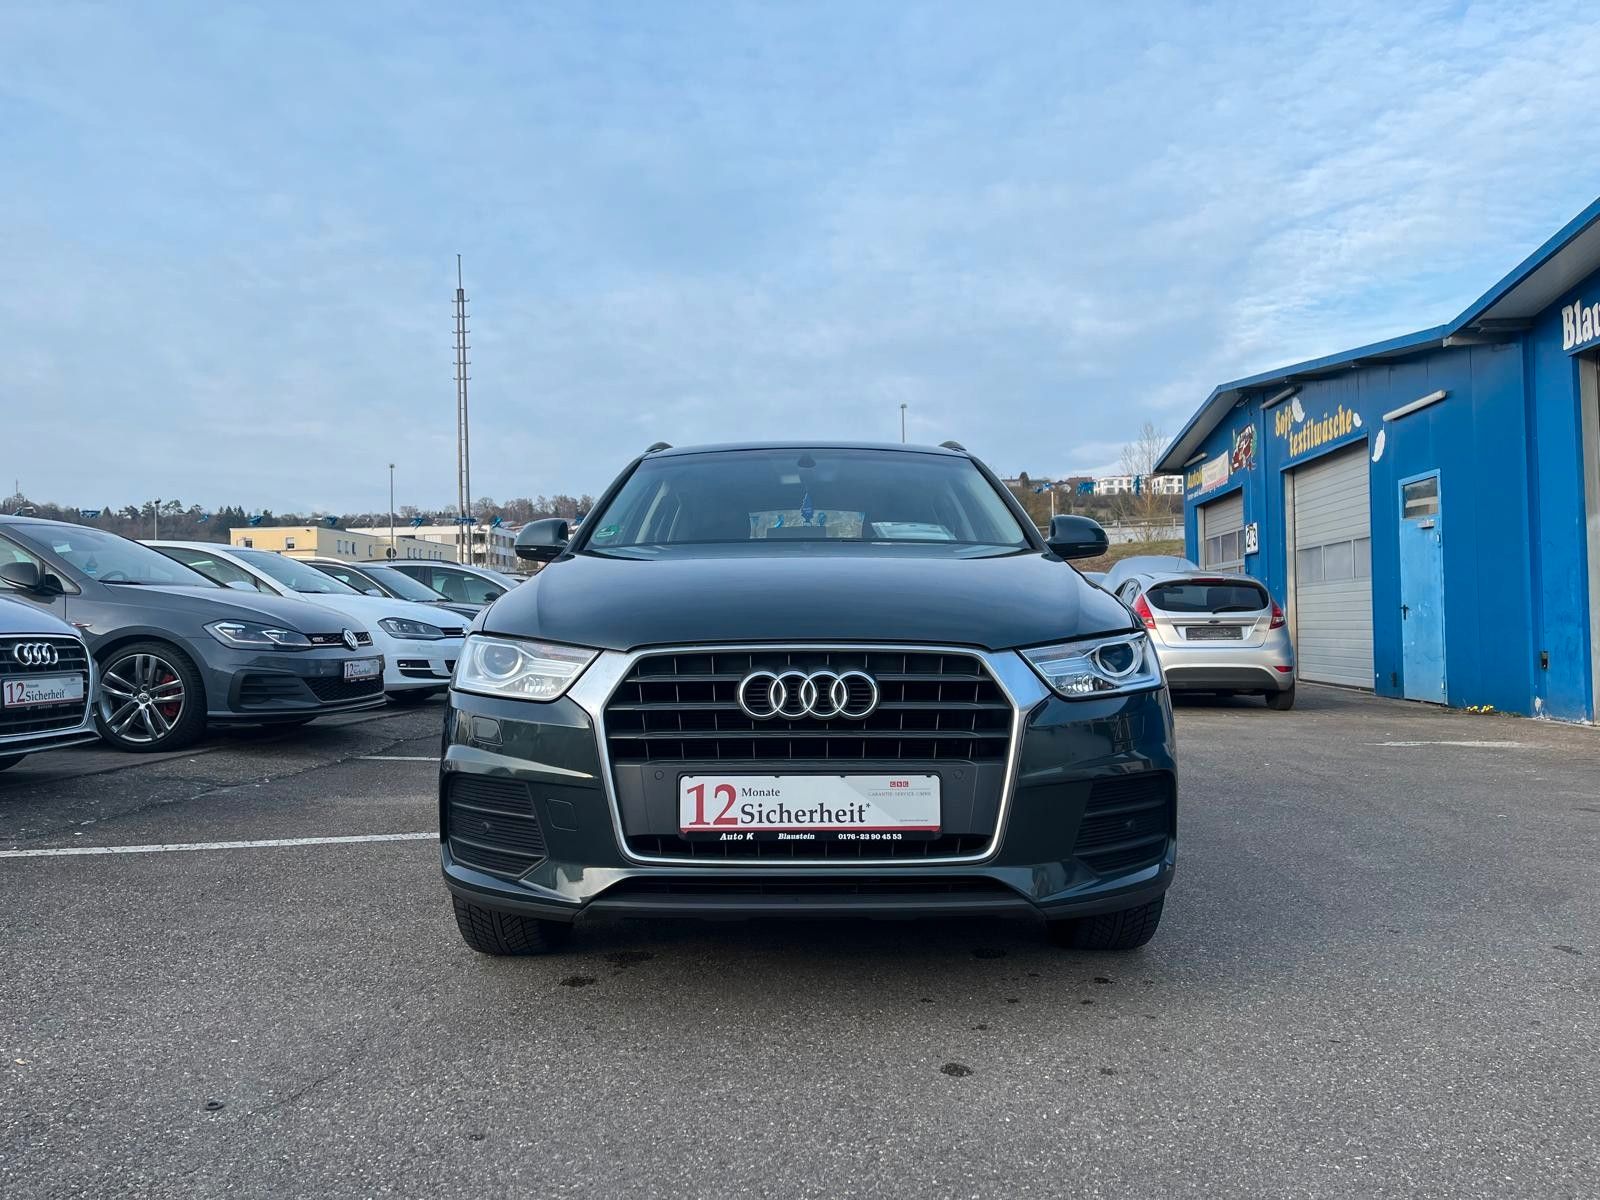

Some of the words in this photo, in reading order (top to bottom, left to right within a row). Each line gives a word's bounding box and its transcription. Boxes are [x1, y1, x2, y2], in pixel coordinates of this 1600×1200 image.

[1289, 404, 1352, 459] textilwäsche
[6, 682, 26, 704] 12
[25, 688, 65, 702] Sicherheit
[742, 787, 781, 797] Monate
[686, 783, 738, 825] 12
[719, 832, 744, 841] Auto
[745, 832, 755, 840] K
[777, 832, 815, 840] Blaustein
